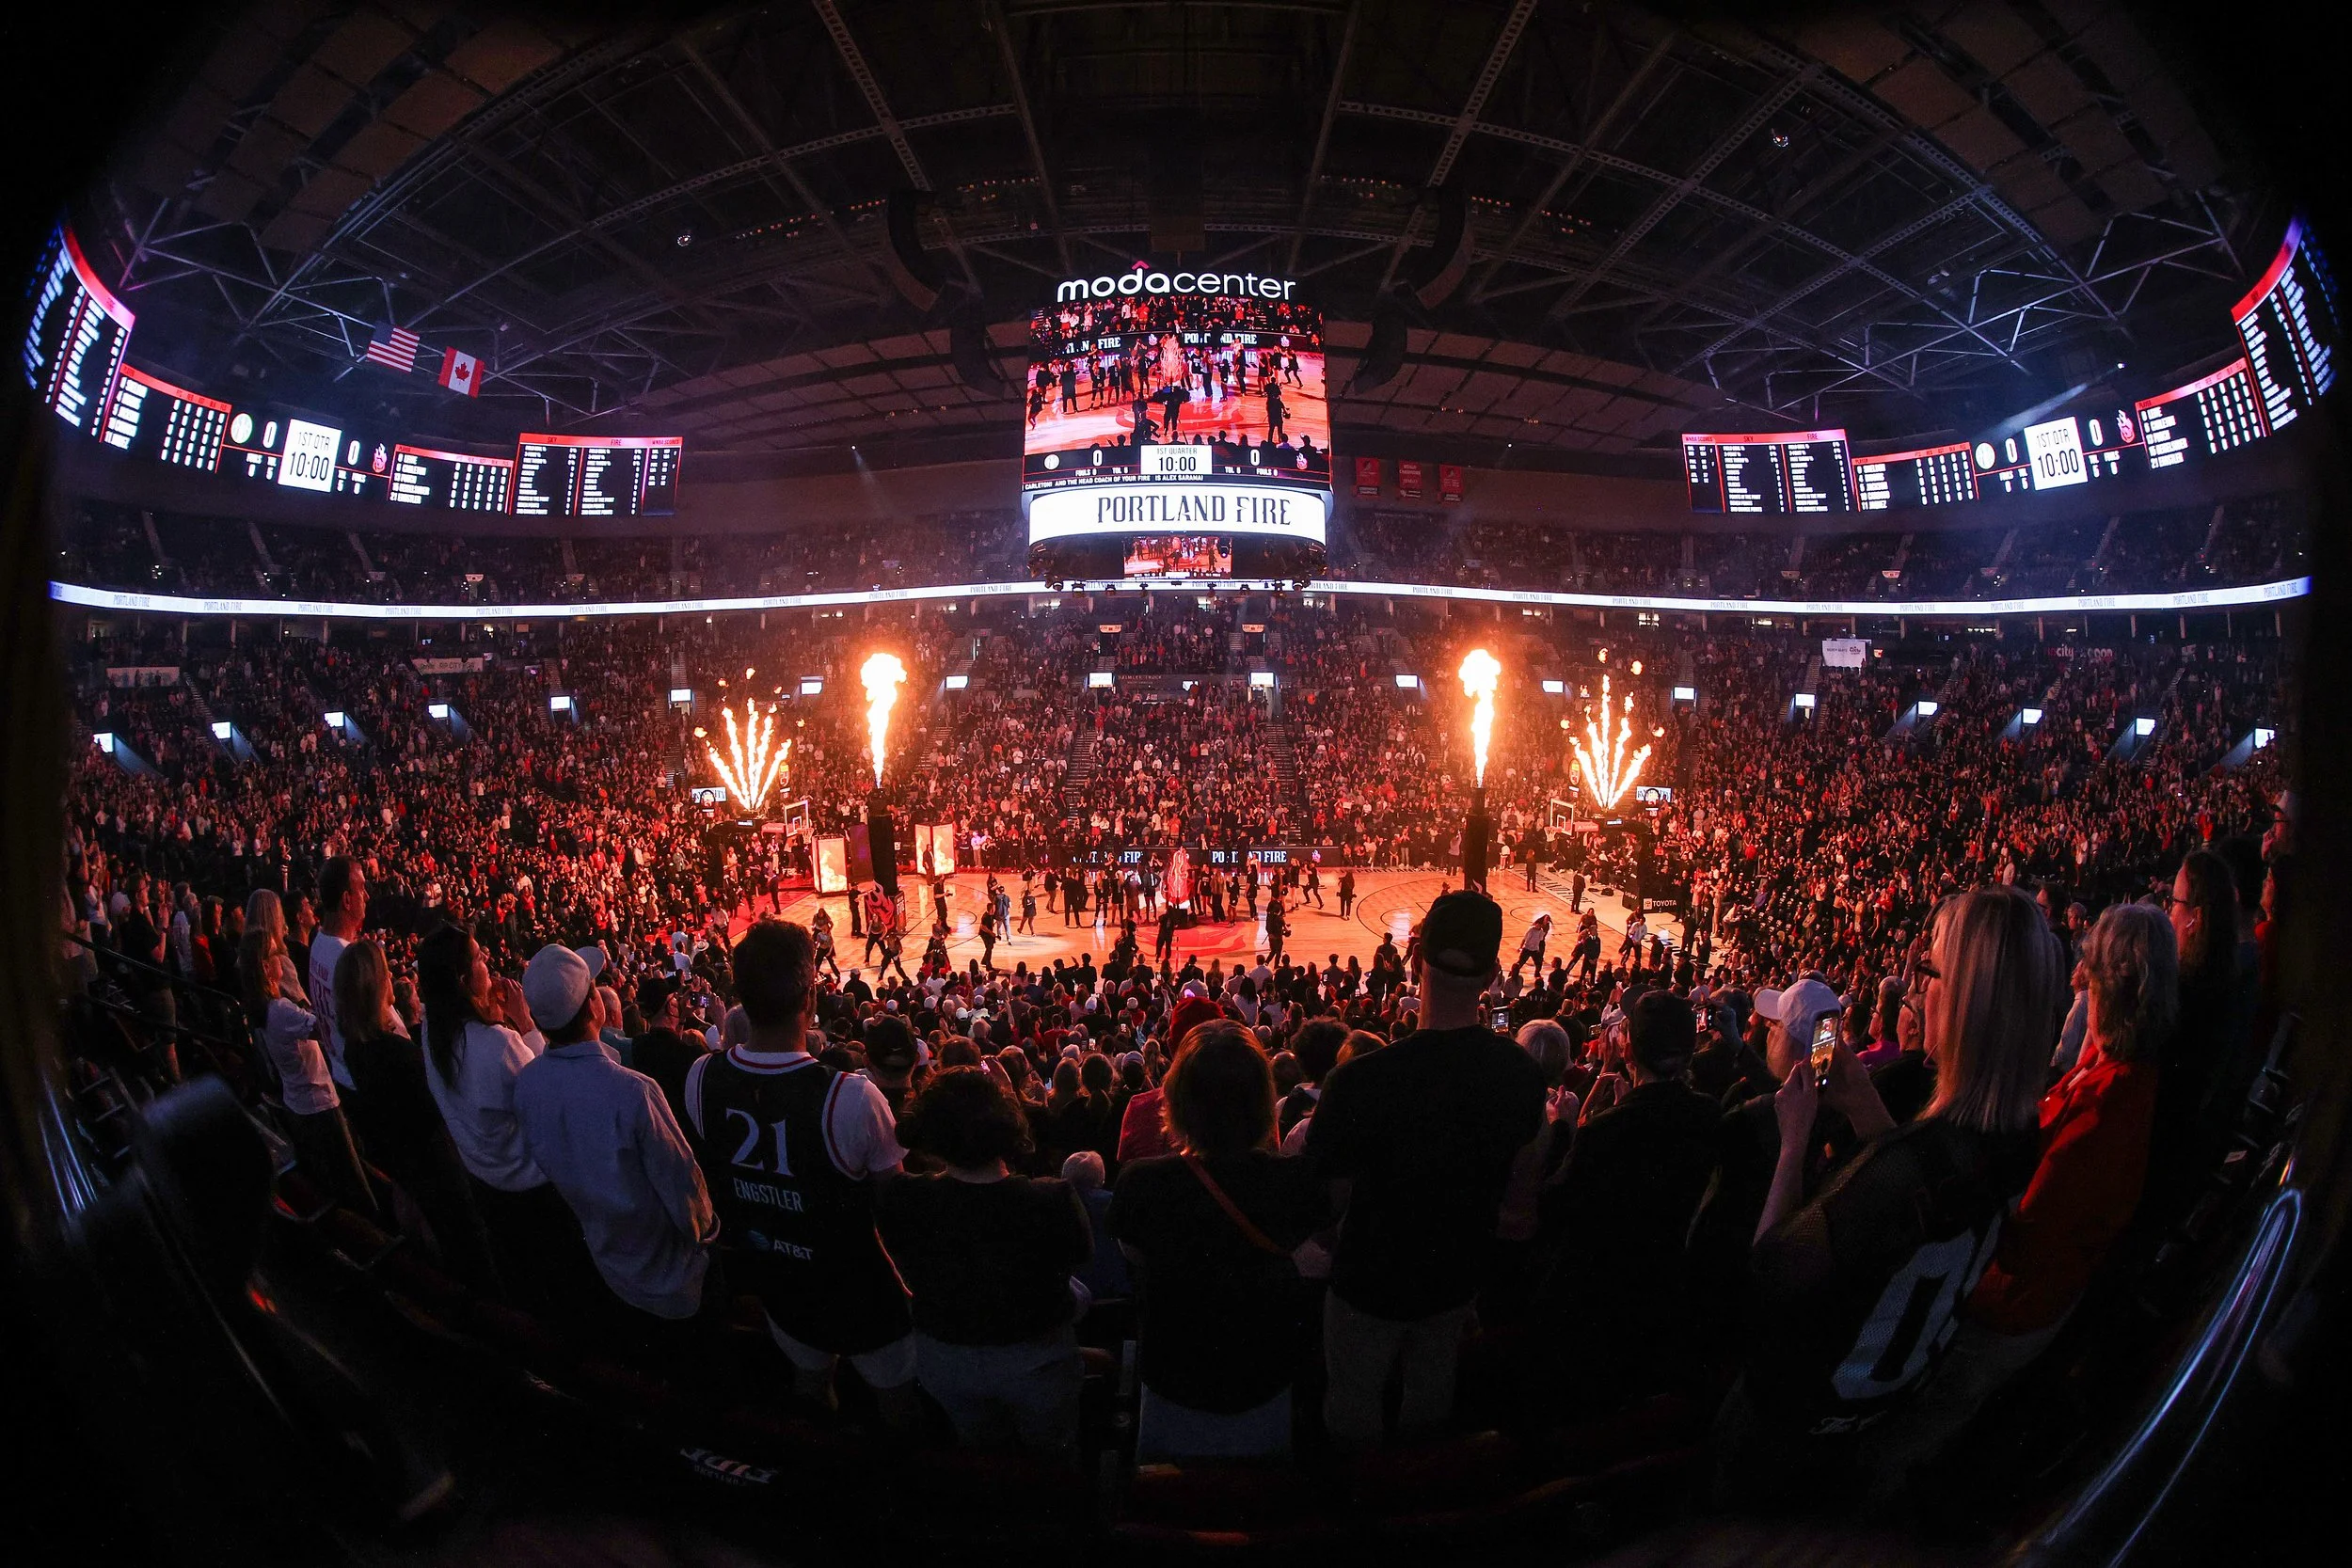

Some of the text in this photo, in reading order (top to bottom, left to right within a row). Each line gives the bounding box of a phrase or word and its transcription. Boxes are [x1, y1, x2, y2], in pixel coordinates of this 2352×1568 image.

[1098, 337, 1121, 350] FIRE
[290, 451, 330, 482] 10:00
[1093, 449, 1104, 467] 0
[1158, 456, 1197, 472] 10:00
[1250, 449, 1261, 467] 0
[2038, 448, 2079, 479] 10:00
[1097, 495, 1292, 526] PORTLAND FIRE
[1263, 850, 1287, 863] FIRE
[1652, 899, 1677, 908] TOYOTA
[725, 1107, 796, 1177] 21
[732, 1177, 805, 1213] ENGSTLER
[772, 1239, 814, 1261] AT&T
